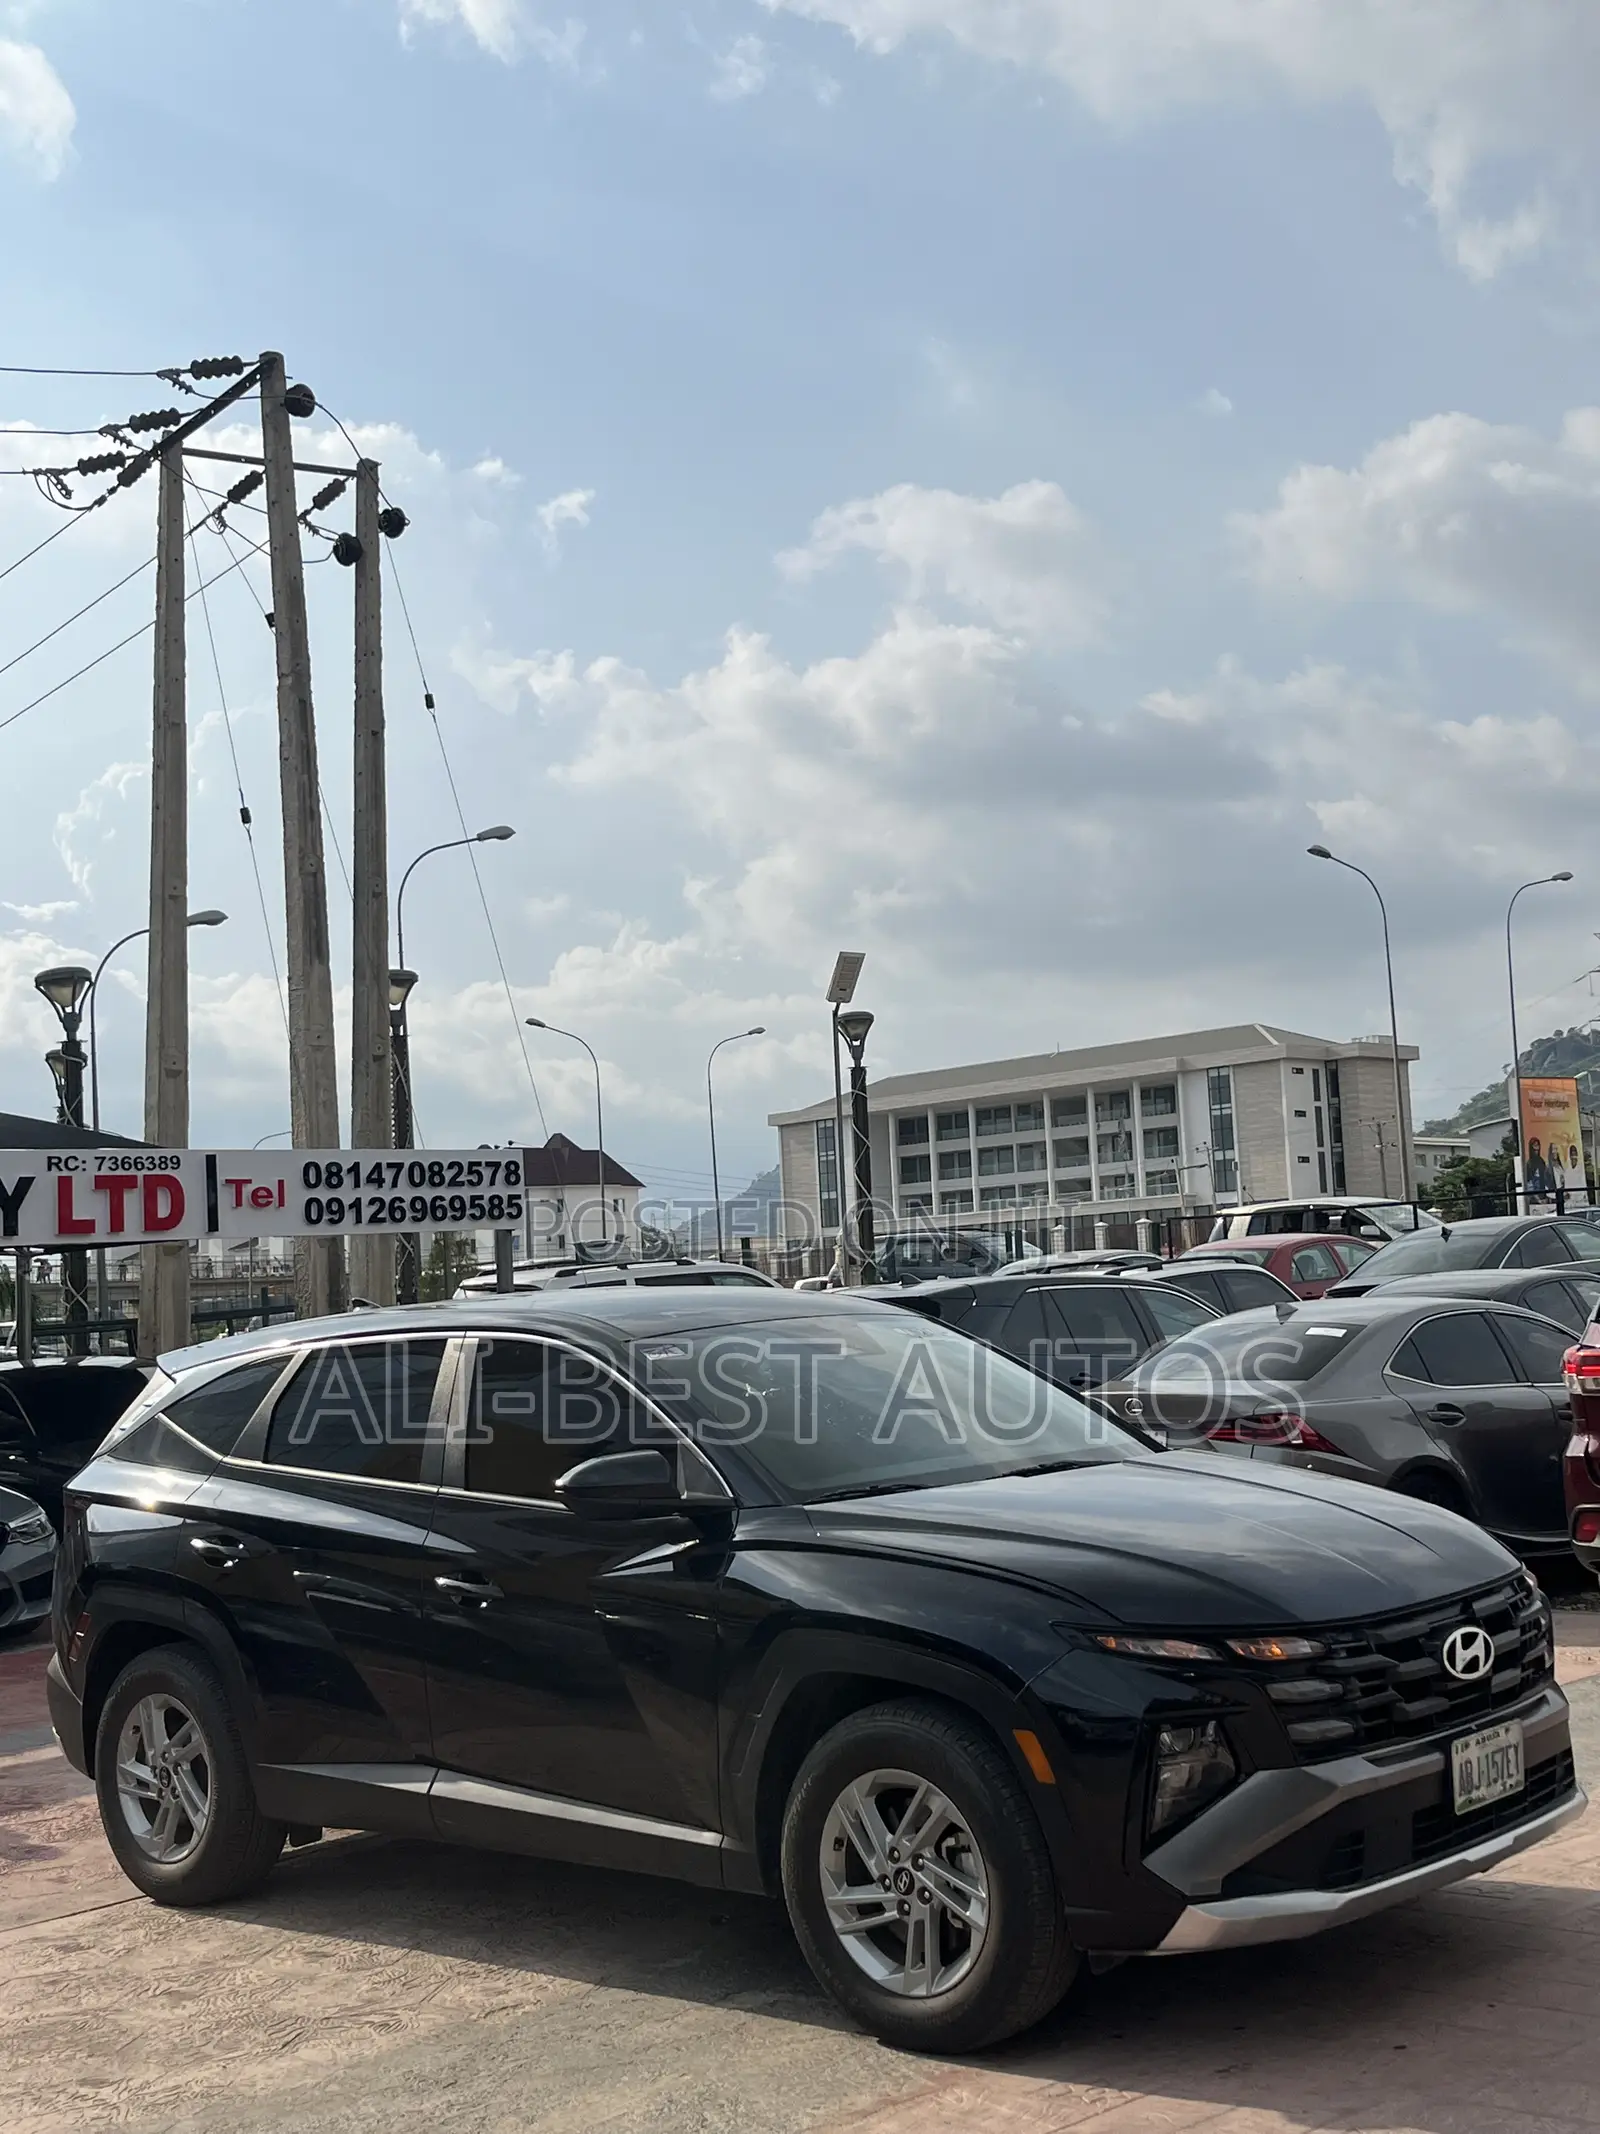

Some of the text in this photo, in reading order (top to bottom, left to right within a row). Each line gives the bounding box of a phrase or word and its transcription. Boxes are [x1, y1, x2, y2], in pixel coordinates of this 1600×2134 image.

[47, 1155, 182, 1172] RC: 7366389
[302, 1160, 522, 1189] 08147082578
[56, 1174, 186, 1236] LTD
[223, 1178, 286, 1208] Tel
[304, 1194, 523, 1225] 09126969585
